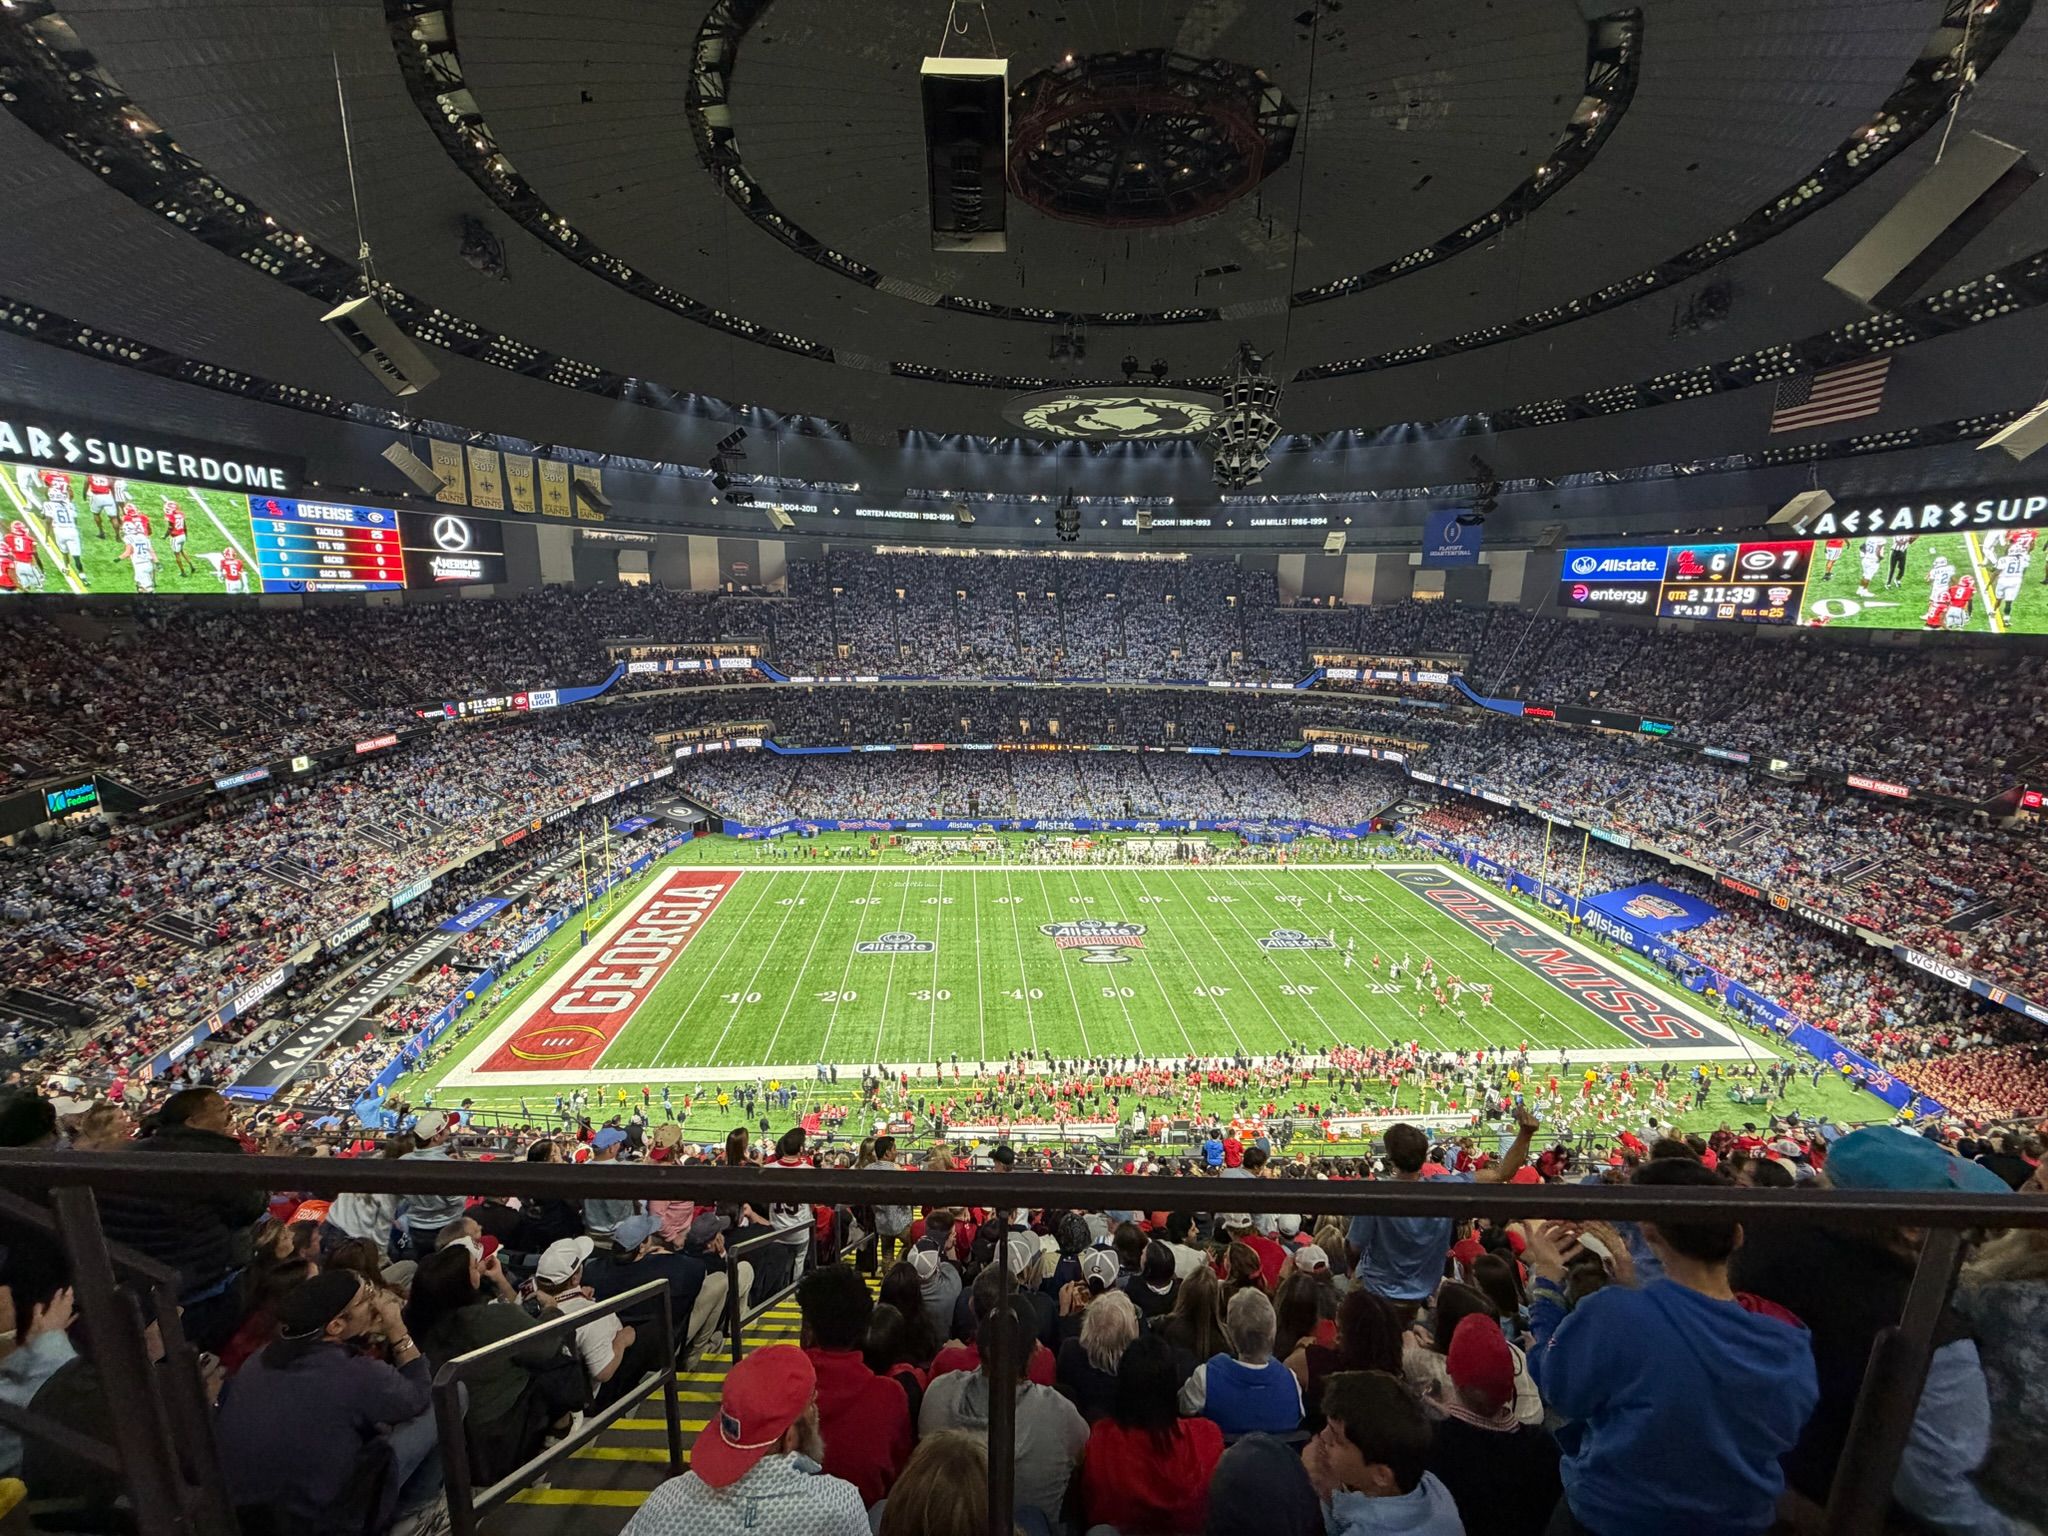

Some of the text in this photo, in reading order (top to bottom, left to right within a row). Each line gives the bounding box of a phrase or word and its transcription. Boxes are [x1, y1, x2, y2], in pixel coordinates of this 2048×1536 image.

[85, 438, 287, 490] SUPERDOME
[438, 457, 457, 466] 2011
[476, 462, 495, 472] 2017
[510, 469, 529, 477] 2018
[544, 473, 564, 482] 2019
[438, 493, 465, 503] SAINTS
[474, 498, 502, 508] SAINTS
[297, 504, 354, 522] DEFENSE
[545, 506, 570, 515] SAINTS
[781, 504, 818, 513] 2004-2013
[856, 509, 884, 517] MORTEN
[885, 511, 919, 520] ANDERSEN
[1250, 517, 1328, 526] SAM MILLS 1986-1994
[272, 522, 384, 540] 15 TACKLES 25
[277, 537, 285, 547] 0
[375, 543, 383, 553] 0
[280, 552, 288, 562] 0
[377, 556, 385, 566] 0
[1677, 550, 1695, 564] Ole
[1711, 554, 1726, 571] 6
[1782, 550, 1798, 570] 7
[282, 567, 290, 577] 0
[379, 570, 387, 580] 0
[1679, 563, 1705, 574] Miss
[1590, 588, 1648, 604] entergy
[1668, 590, 1688, 601] QTR
[1688, 589, 1699, 601] 2
[1703, 587, 1756, 604] 11:39
[1719, 607, 1732, 615] 40
[1769, 608, 1784, 617] 25
[505, 696, 512, 707] 7
[534, 692, 551, 700] BUD
[458, 702, 466, 713] 6
[473, 698, 497, 709] 11:39
[532, 699, 554, 707] LIGHT
[423, 710, 444, 718] TOYOTA
[1523, 706, 1554, 717] verizon
[215, 775, 245, 789] VENTURE
[65, 784, 94, 797] Keesler
[67, 792, 95, 807] Federal
[947, 821, 973, 829] Allstate
[1035, 821, 1074, 829] Allstate
[1541, 811, 1572, 828] Ochsner
[502, 829, 527, 847] verizon
[1721, 877, 1760, 898] verizon
[393, 890, 413, 908] PEOPLES
[1774, 895, 1788, 908] 40
[456, 902, 498, 927] Allstate
[1582, 909, 1634, 944] Allstate
[1798, 907, 1849, 935] CAESARS
[332, 917, 371, 948] Ochsner
[1055, 927, 1131, 936] Allstate
[550, 884, 726, 1014] GEORGIA
[863, 941, 926, 951] Allstate
[1424, 888, 1538, 937] OLE
[1511, 947, 1705, 1041] MISS
[1910, 952, 1956, 979] WGNO
[1009, 988, 1044, 1000] 40
[1102, 987, 1135, 998] 50
[1194, 986, 1226, 997] 40
[1279, 984, 1311, 995] 30
[1365, 983, 1400, 993] 20
[727, 992, 761, 1003] 10
[821, 990, 857, 1002] 20
[914, 989, 951, 1001] 30
[269, 934, 451, 1070] CAESARS SUPERDOME
